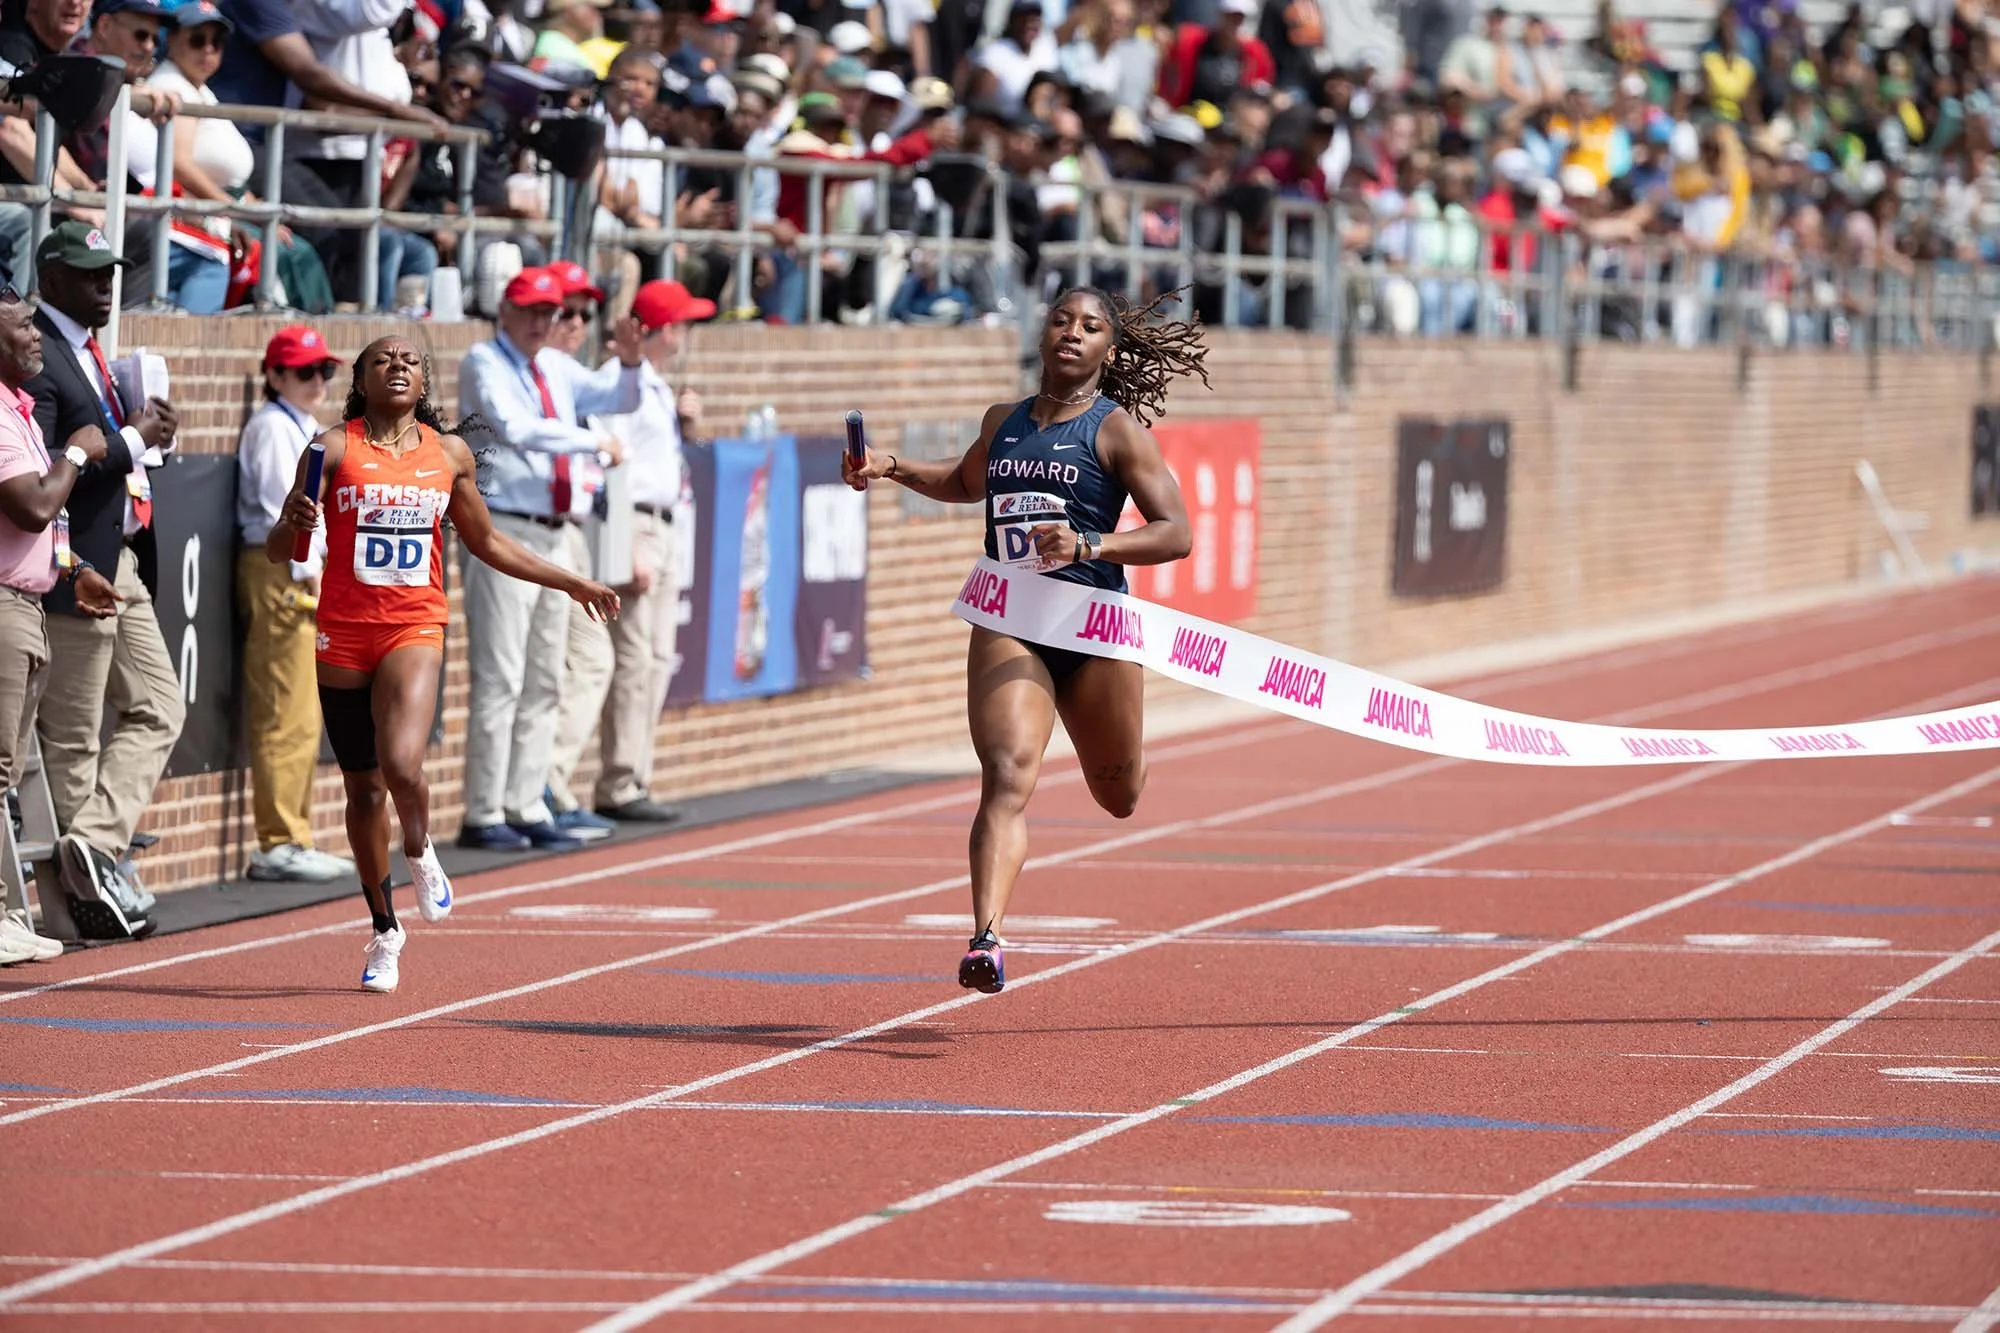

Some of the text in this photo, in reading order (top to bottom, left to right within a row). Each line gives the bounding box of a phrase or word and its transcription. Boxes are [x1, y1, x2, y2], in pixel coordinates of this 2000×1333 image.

[988, 459, 1079, 484] HOWARD
[1020, 495, 1048, 504] PENN
[389, 517, 427, 525] RELAYS
[391, 509, 420, 517] PENN
[365, 536, 423, 569] DD
[1076, 601, 1145, 651] JAMAICA
[1168, 626, 1228, 678] JAMAICA
[1258, 656, 1326, 709] JAMAICA
[1363, 687, 1433, 739] JAMAICA
[1484, 718, 1570, 757] JAMAICA
[1620, 736, 1719, 757] JAMAICA
[1768, 733, 1867, 752] JAMAICA
